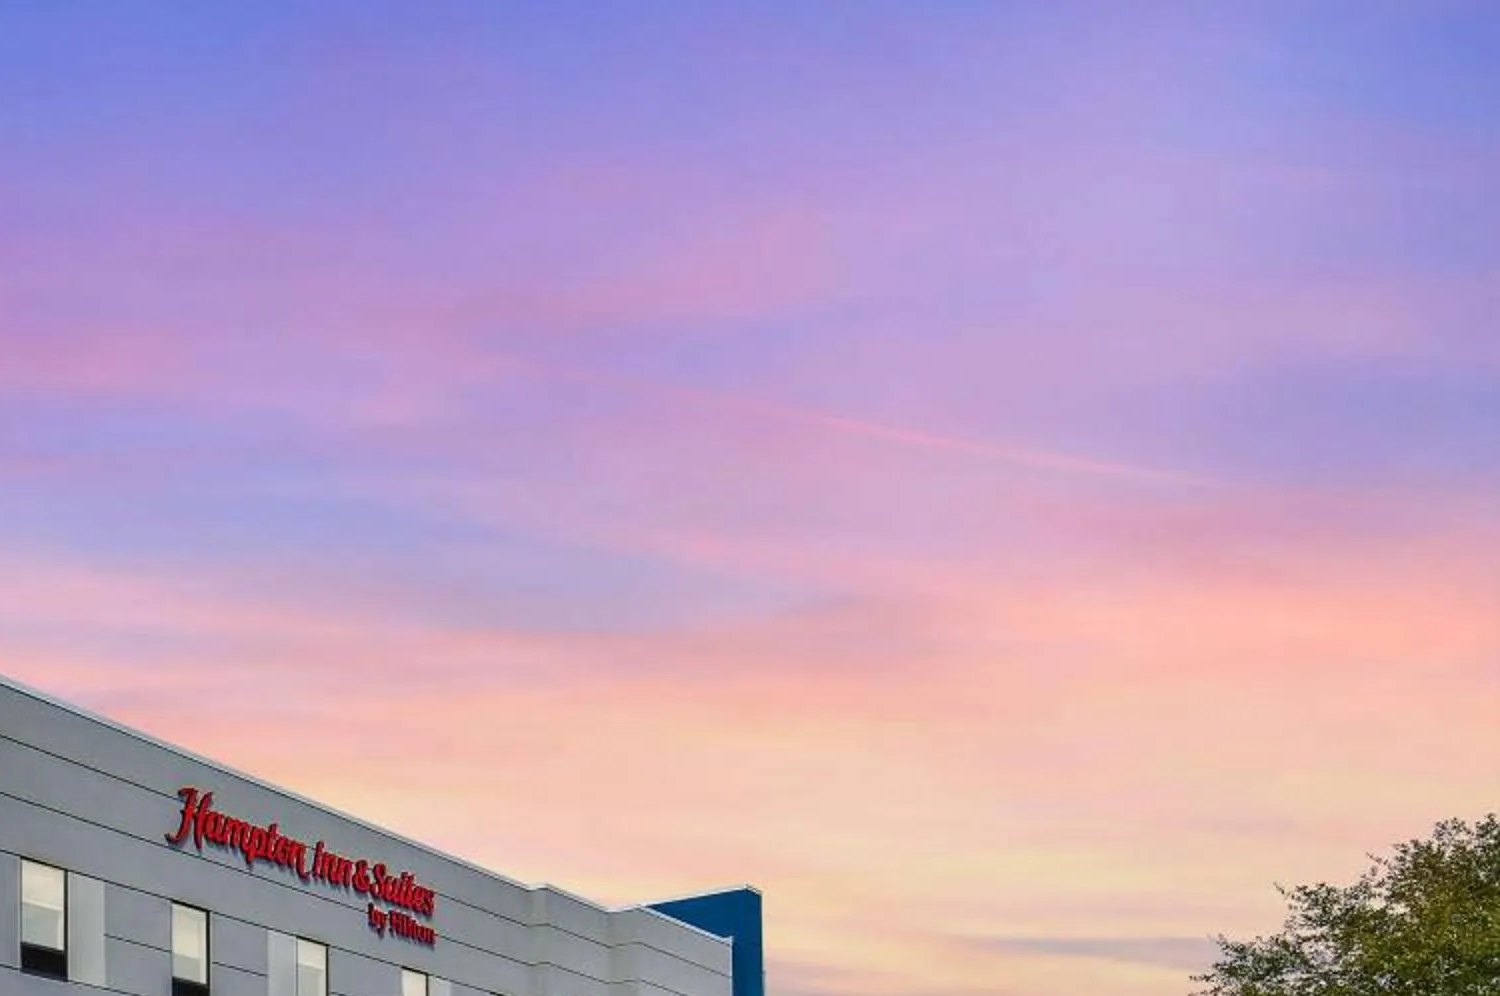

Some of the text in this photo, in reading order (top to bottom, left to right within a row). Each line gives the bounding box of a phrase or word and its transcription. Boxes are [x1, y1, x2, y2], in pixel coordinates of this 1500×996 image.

[164, 787, 310, 879] Hampton
[367, 902, 436, 946] by Hilton
